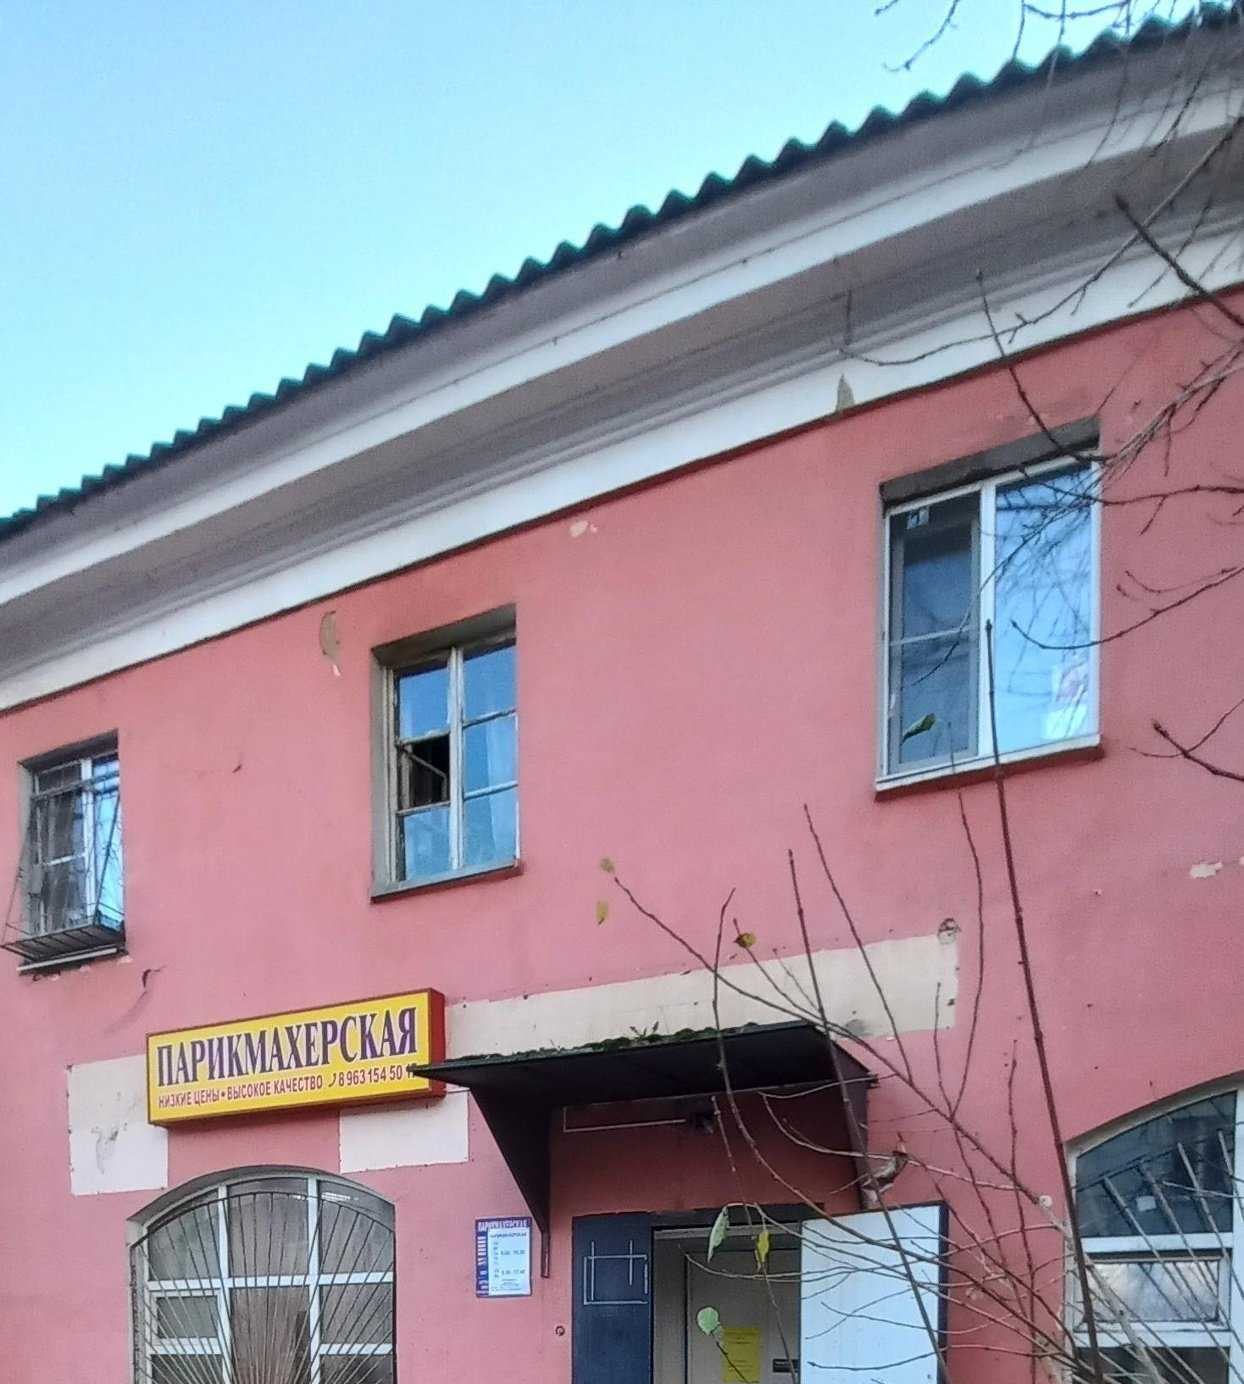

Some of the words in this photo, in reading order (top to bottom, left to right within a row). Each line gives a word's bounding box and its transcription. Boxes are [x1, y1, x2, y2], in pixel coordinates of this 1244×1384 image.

[157, 1007, 417, 1087] ПАРИКМАХЕРСКАЯ
[158, 1091, 192, 1108] НИЗКИЕ
[194, 1089, 220, 1106] ЦЕНЫ
[227, 1082, 271, 1100] ВЫСОКОЕ
[274, 1075, 323, 1094] КАЧЕСТВО
[346, 1068, 366, 1086] 963
[368, 1066, 386, 1083] 154
[389, 1064, 403, 1080] 50
